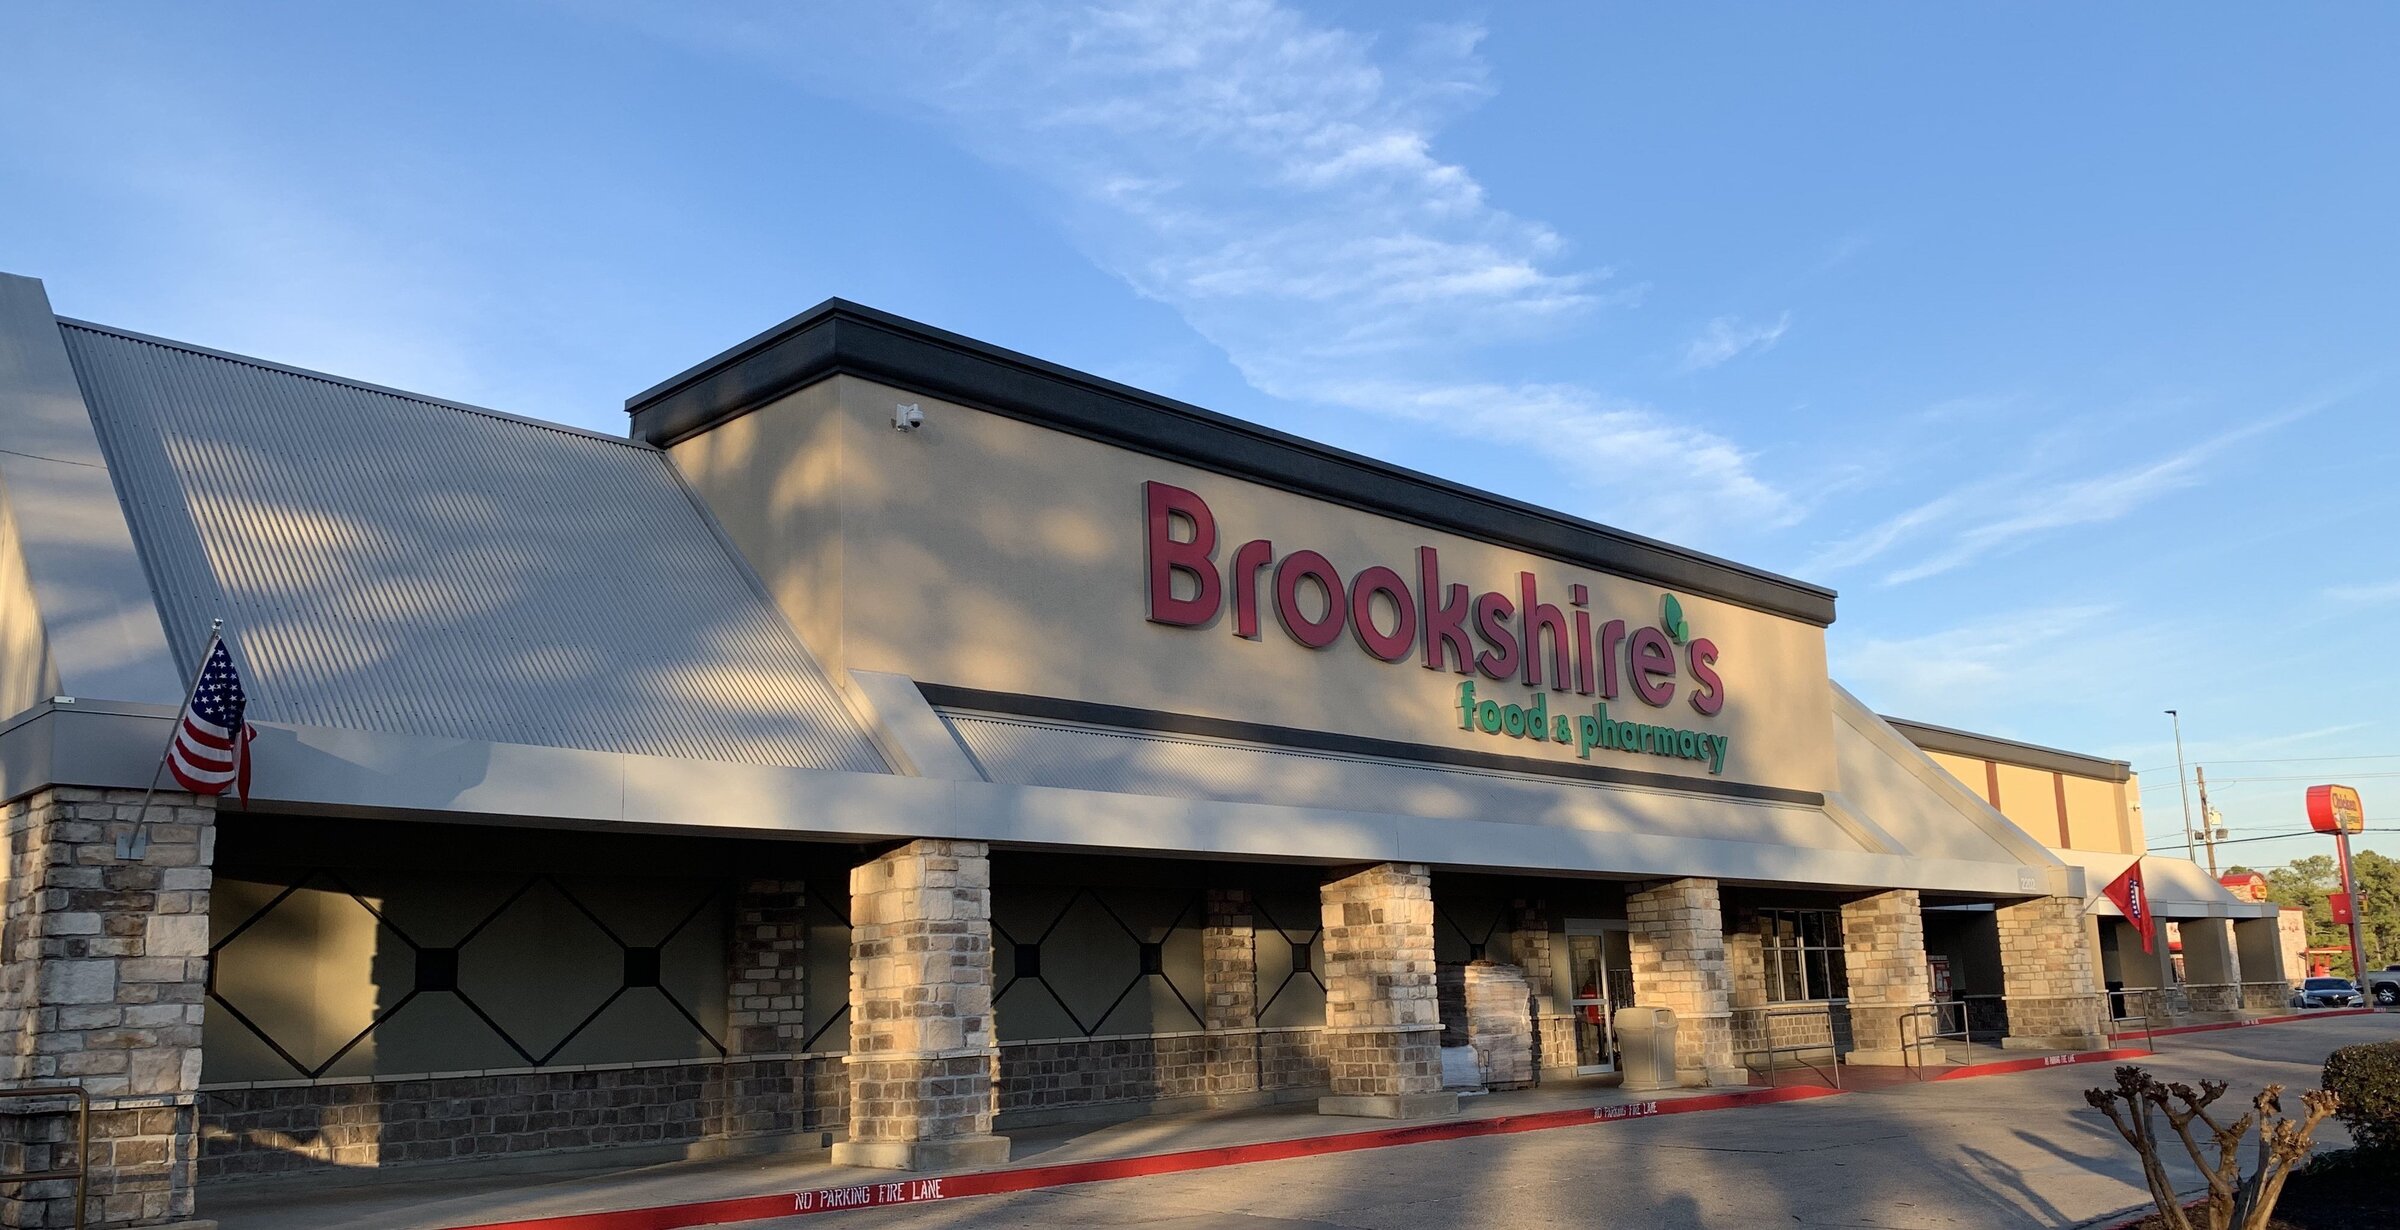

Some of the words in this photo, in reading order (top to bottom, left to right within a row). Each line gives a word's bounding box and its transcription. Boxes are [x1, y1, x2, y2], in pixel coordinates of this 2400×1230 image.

[1143, 480, 1725, 716] Brookshire's
[1456, 680, 1549, 741] food
[1553, 714, 1573, 745] &
[1575, 702, 1729, 775] pharmacy
[795, 1193, 812, 1210] NO
[820, 1186, 870, 1208] PARKING
[878, 1182, 905, 1203] FIRE
[912, 1179, 944, 1200] LANE
